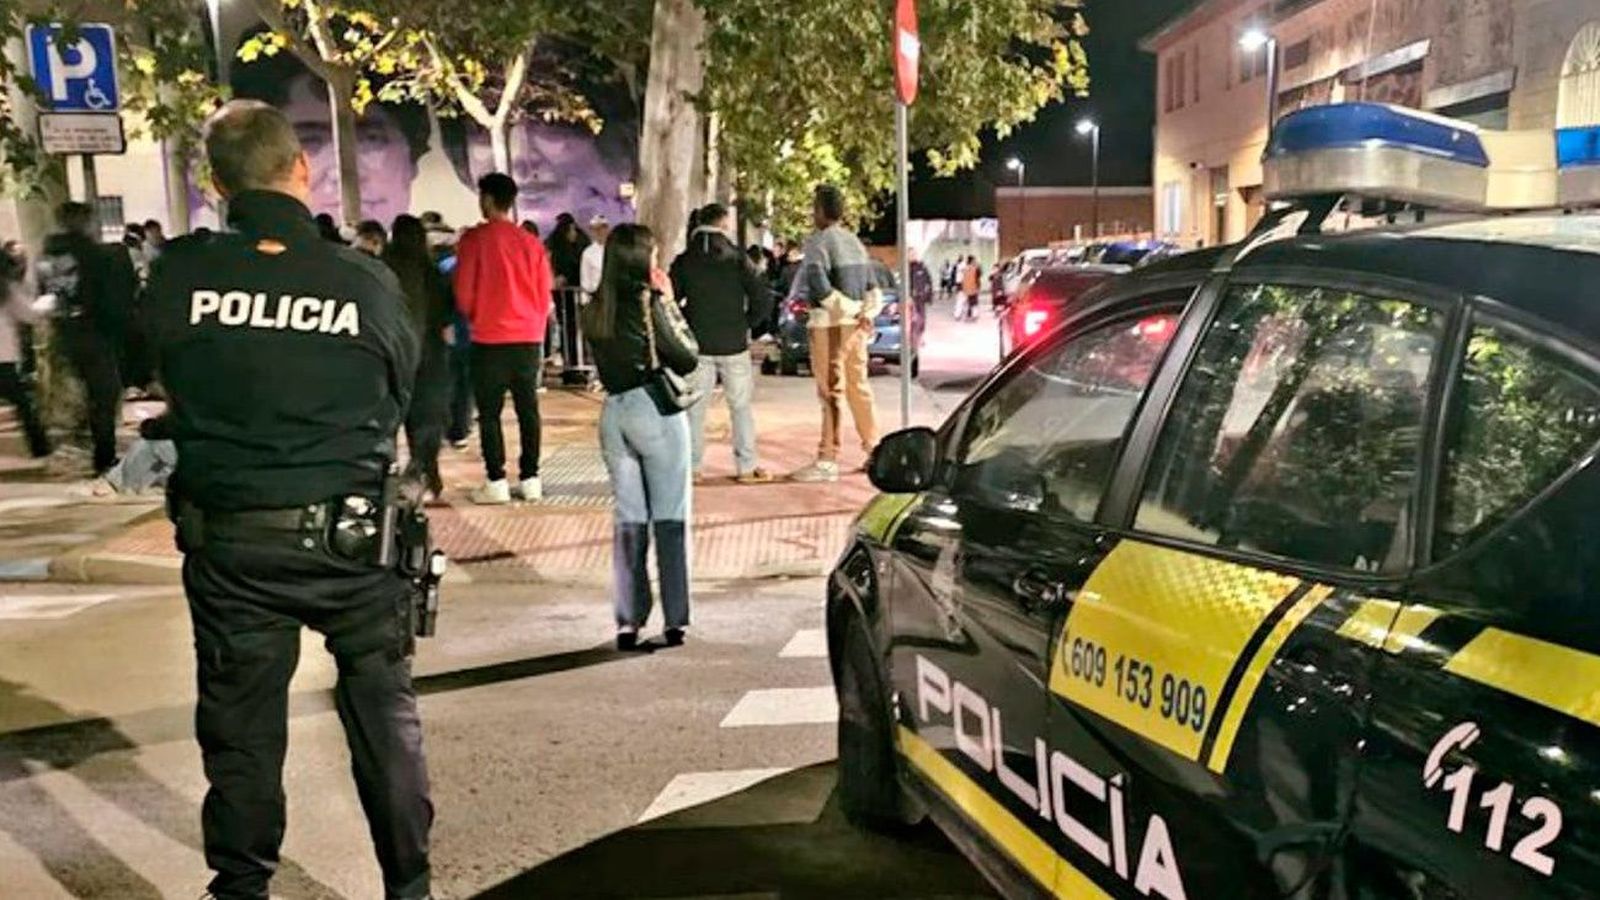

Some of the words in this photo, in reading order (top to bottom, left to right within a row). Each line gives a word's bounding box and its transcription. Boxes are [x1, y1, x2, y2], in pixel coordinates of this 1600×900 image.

[46, 35, 97, 101] P
[189, 290, 360, 336] POLICIA
[1071, 637, 1107, 687] 609
[1114, 655, 1153, 709] 153
[1160, 673, 1207, 732] 909
[916, 654, 1187, 900] POLICÍA
[1442, 765, 1563, 876] 112
